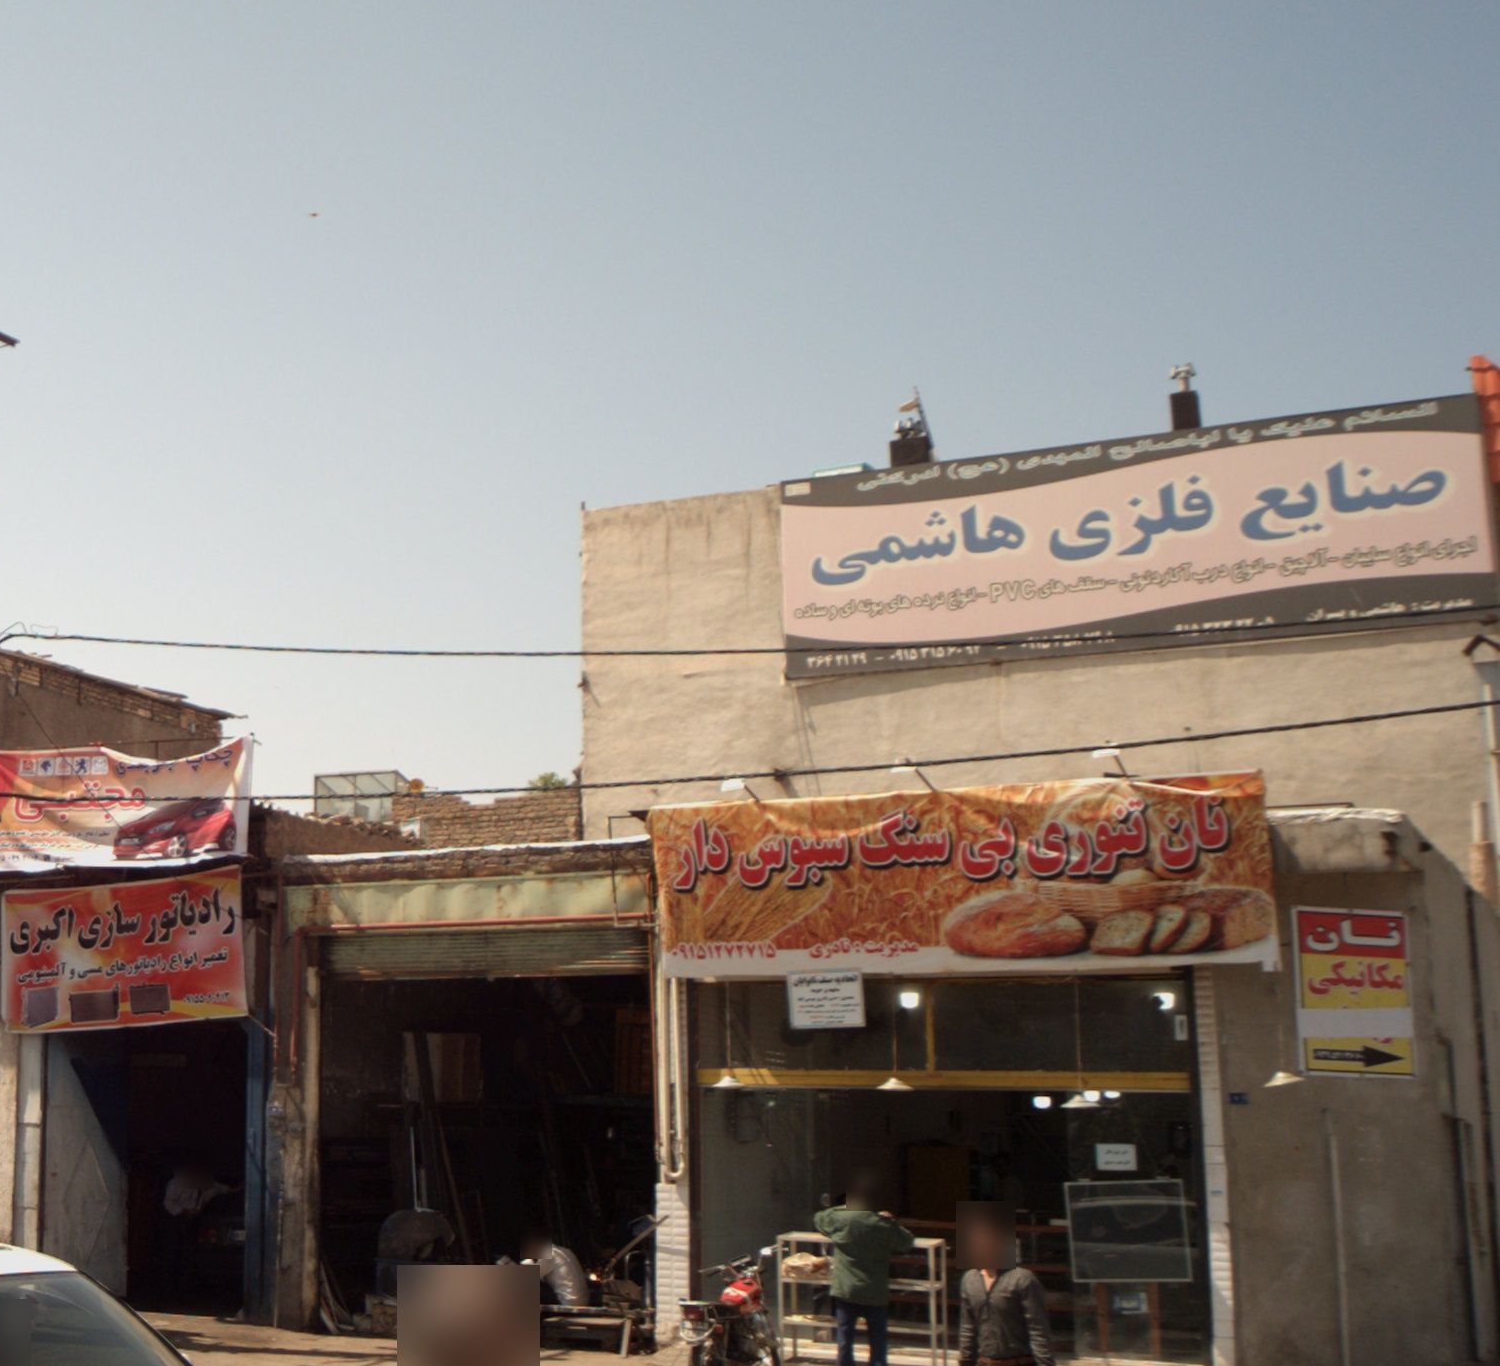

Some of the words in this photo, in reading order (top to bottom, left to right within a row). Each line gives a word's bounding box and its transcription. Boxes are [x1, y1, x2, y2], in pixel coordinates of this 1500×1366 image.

[1049, 474, 1215, 562] فلزی
[1240, 460, 1447, 541] صنایع
[811, 503, 1026, 585] هاشمی
[990, 579, 1035, 603] PVC
[1038, 580, 1066, 599] های
[13, 780, 146, 822] مجتبی
[673, 818, 729, 890] دار
[737, 832, 849, 888] سبوس
[858, 810, 950, 867] سنگ
[960, 818, 1015, 879] بی
[1026, 797, 1148, 877] تنوری
[1158, 795, 1229, 870] نان
[10, 905, 76, 955] اکبری
[77, 902, 141, 949] سازی
[144, 888, 237, 943] رادیاتور
[1305, 918, 1401, 952] نان
[809, 937, 851, 959] نادری
[864, 938, 919, 958] مدیریت
